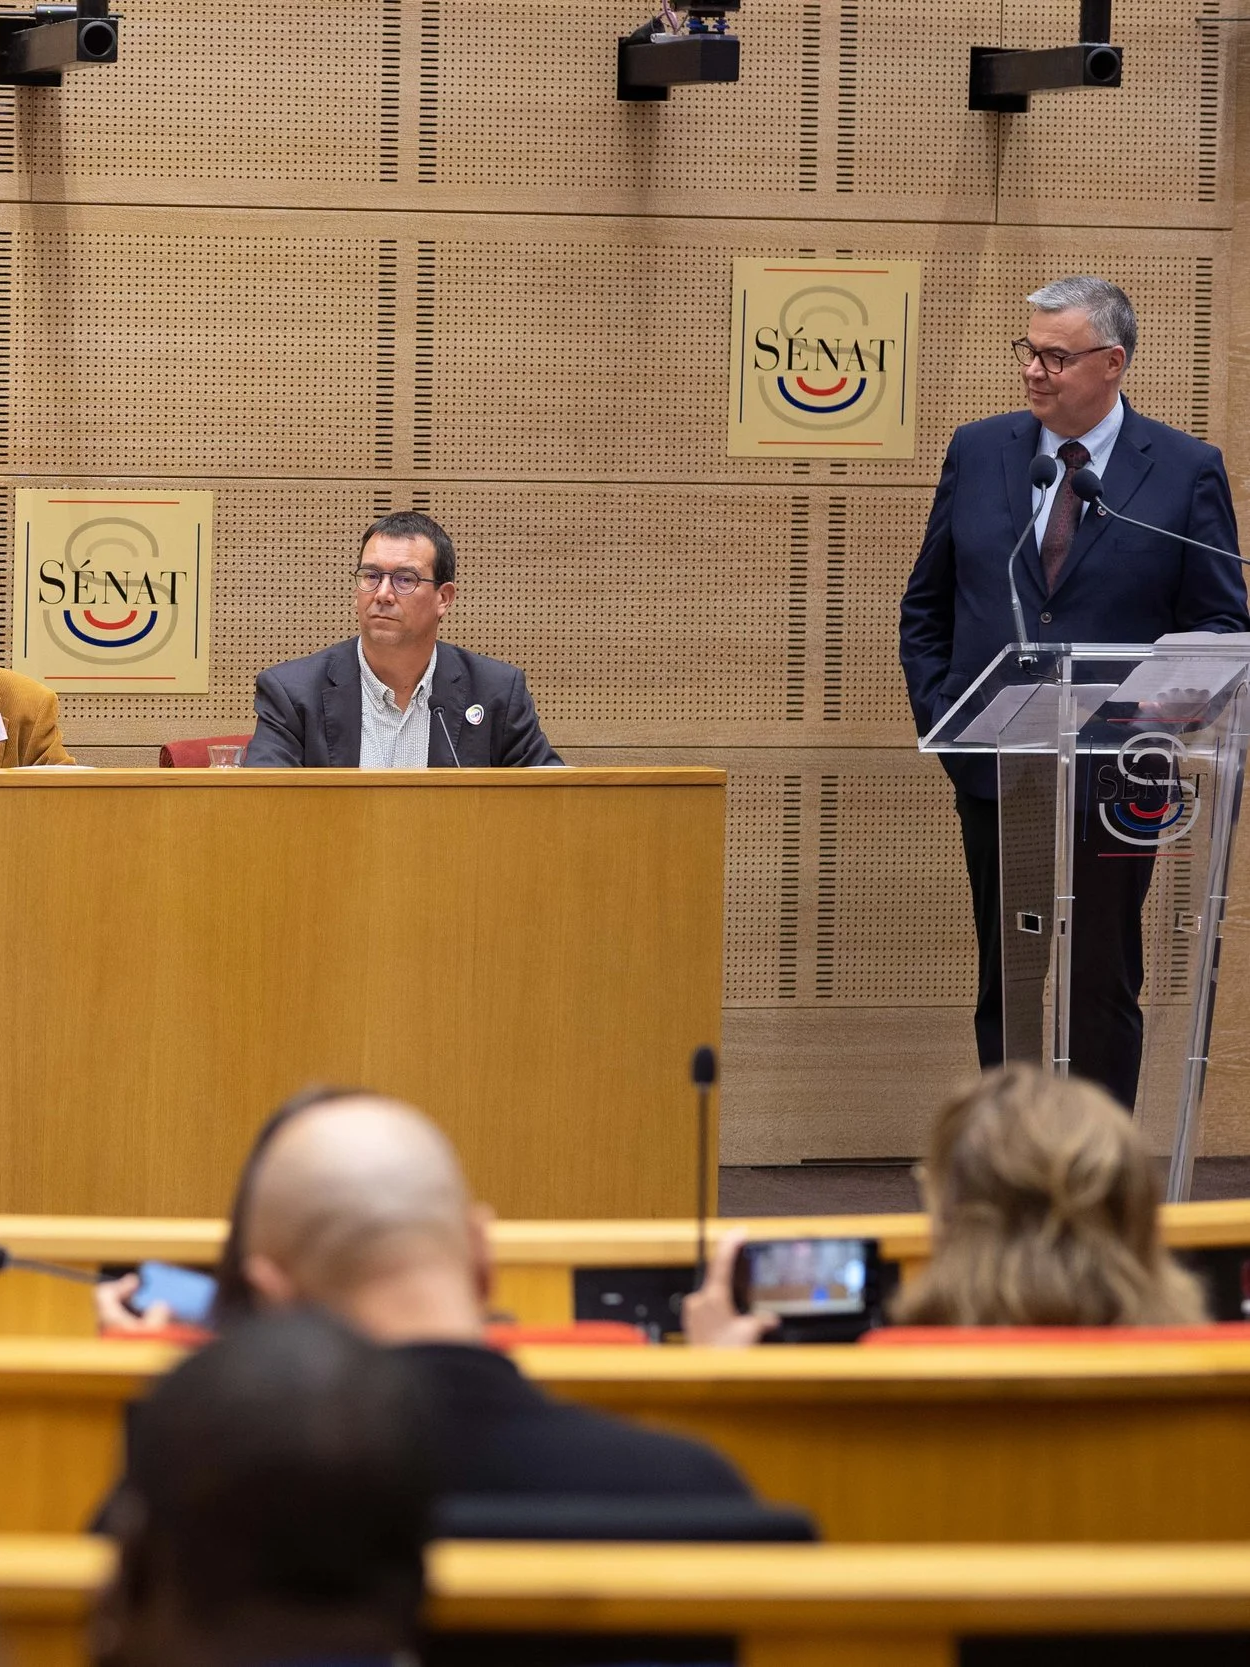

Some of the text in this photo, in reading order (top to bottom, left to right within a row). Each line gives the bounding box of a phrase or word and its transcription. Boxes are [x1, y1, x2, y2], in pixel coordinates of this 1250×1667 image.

[753, 326, 896, 372] SÉNAT
[38, 559, 188, 605] SÉNAT
[1096, 763, 1208, 801] SÉNAT
